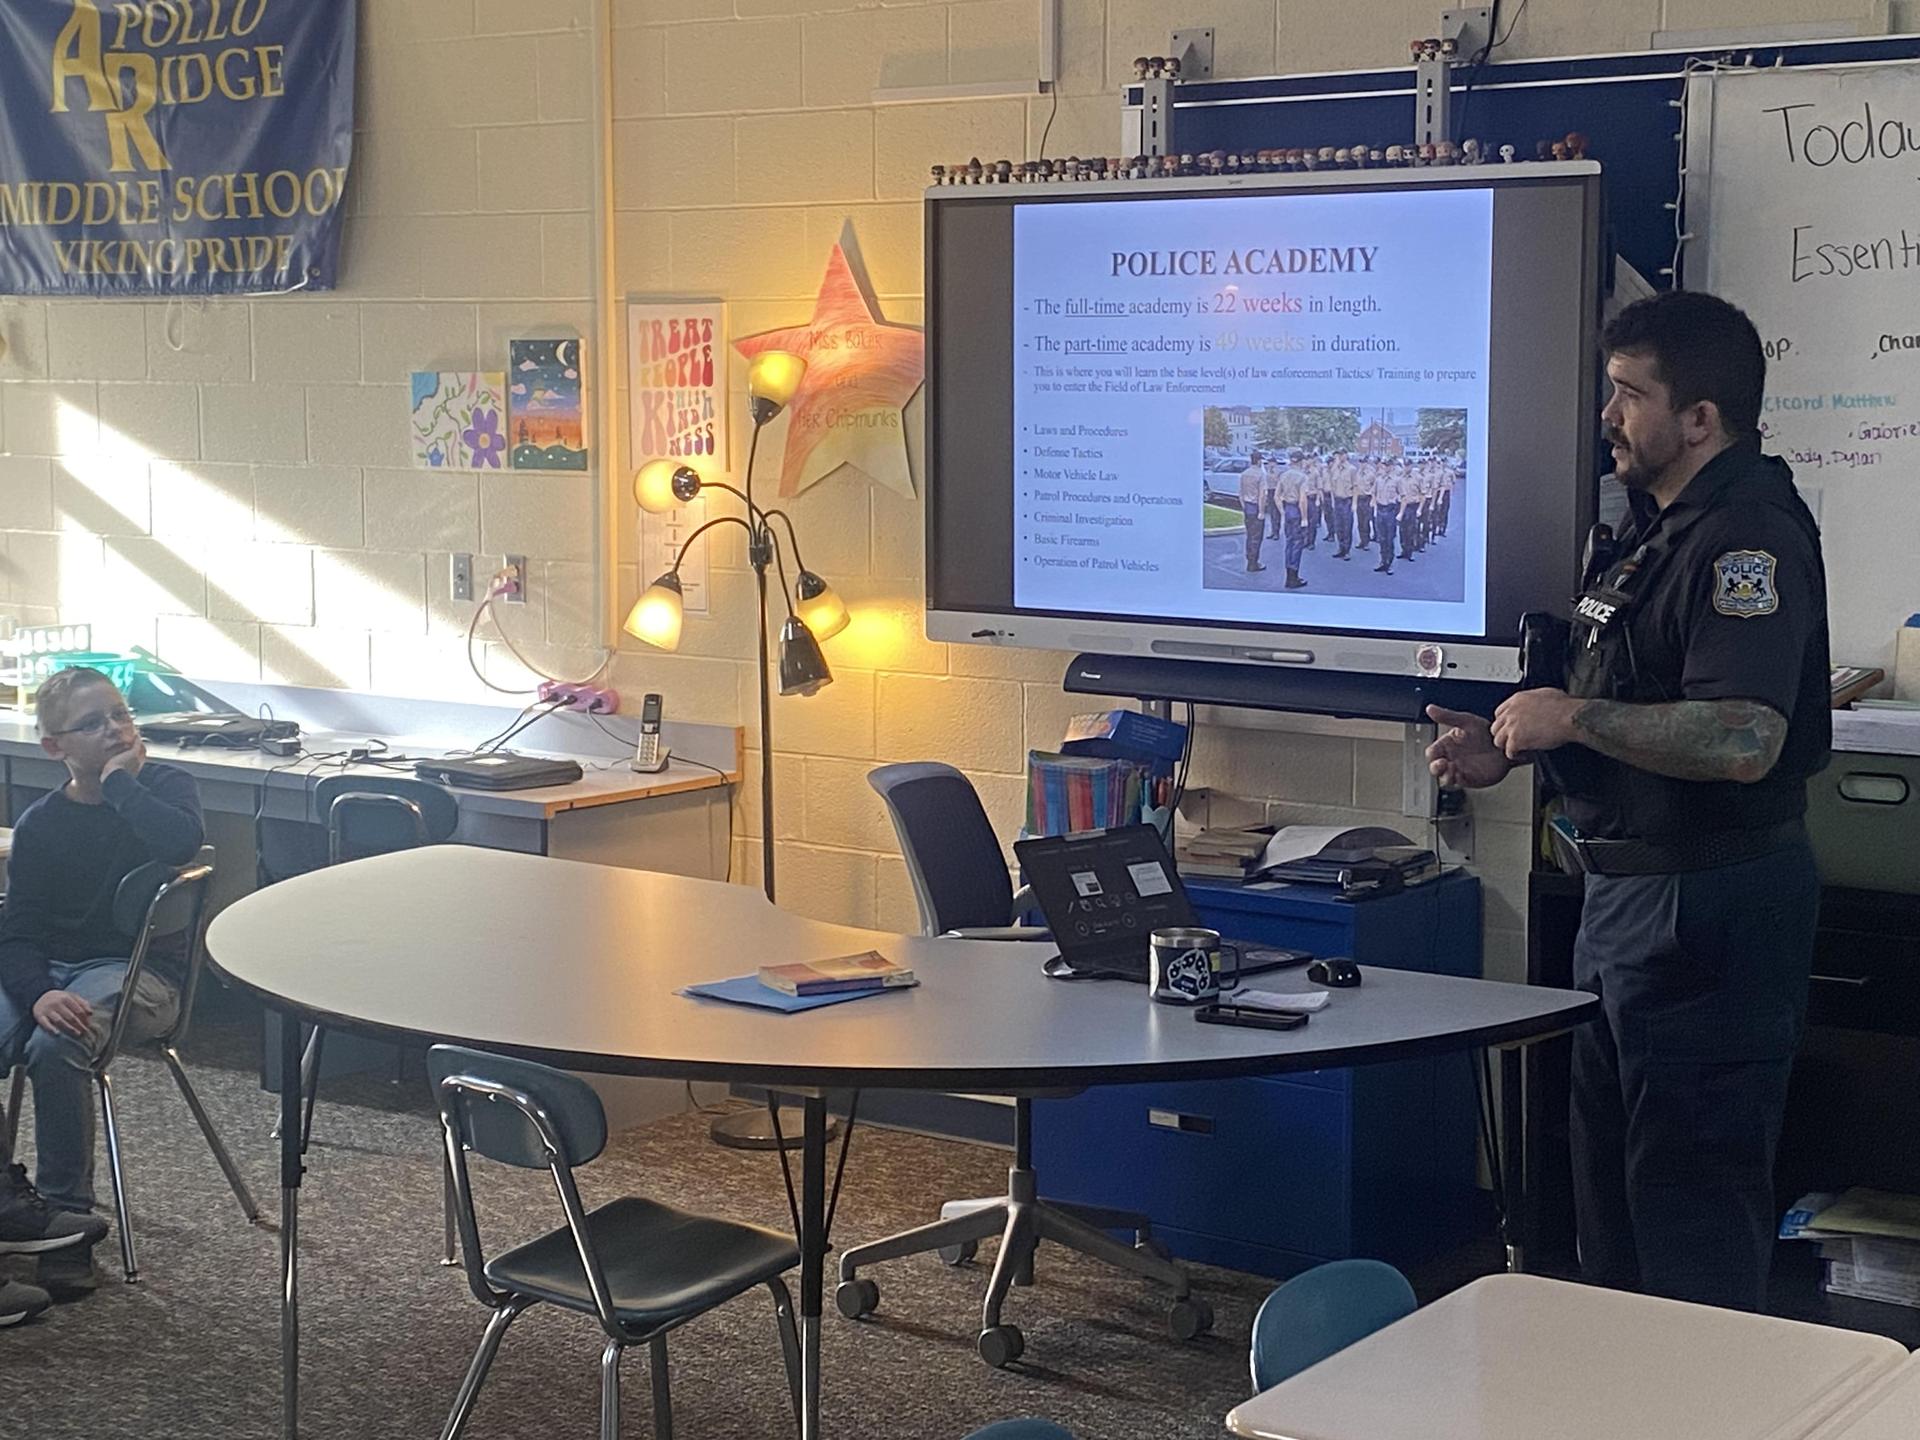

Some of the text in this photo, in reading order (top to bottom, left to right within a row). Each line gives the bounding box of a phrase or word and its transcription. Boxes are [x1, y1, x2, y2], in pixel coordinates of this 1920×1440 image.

[50, 0, 268, 112] APOLLO
[103, 45, 285, 172] RIDGE
[0, 180, 160, 226] MIDDLE
[53, 234, 294, 274] VIKING PRIDE
[1111, 246, 1379, 277] POLICE ACADEMY
[1034, 292, 1381, 317] The full-time academy is 22 weeks in length.
[639, 319, 714, 364] TREAT
[1034, 330, 1400, 355] The part-time academy is 49 weeks in duration.
[640, 345, 714, 388] PEOPLE
[1034, 366, 1054, 377] This
[1056, 366, 1064, 377] is
[1066, 366, 1089, 378] where
[1090, 369, 1112, 379] you
[1114, 366, 1133, 378] will
[1135, 366, 1158, 378] learn
[1160, 367, 1175, 378] the
[1177, 367, 1199, 378] base
[1201, 367, 1236, 380] level(s)
[1238, 367, 1250, 378] of
[1251, 367, 1267, 379] law
[1271, 367, 1332, 379] enforcement
[1377, 367, 1420, 381] Training
[1424, 369, 1434, 379] to
[1436, 369, 1477, 382] prepare
[1034, 381, 1226, 394] you to enter the Field of Law Enforcement
[1034, 424, 1128, 437] Laws and Procedures
[1034, 446, 1103, 459] Defense Tactics
[1034, 468, 1119, 481] Motor Vehicle Law
[1034, 490, 1183, 506] Patrol Procedures and Operations
[1033, 512, 1134, 527] Criminal Investigation
[1034, 533, 1100, 547] Basic Firearms
[1034, 555, 1159, 572] Operation of Patrol Vehicles
[1721, 564, 1769, 576] POLICE
[1574, 596, 1616, 623] POLICE
